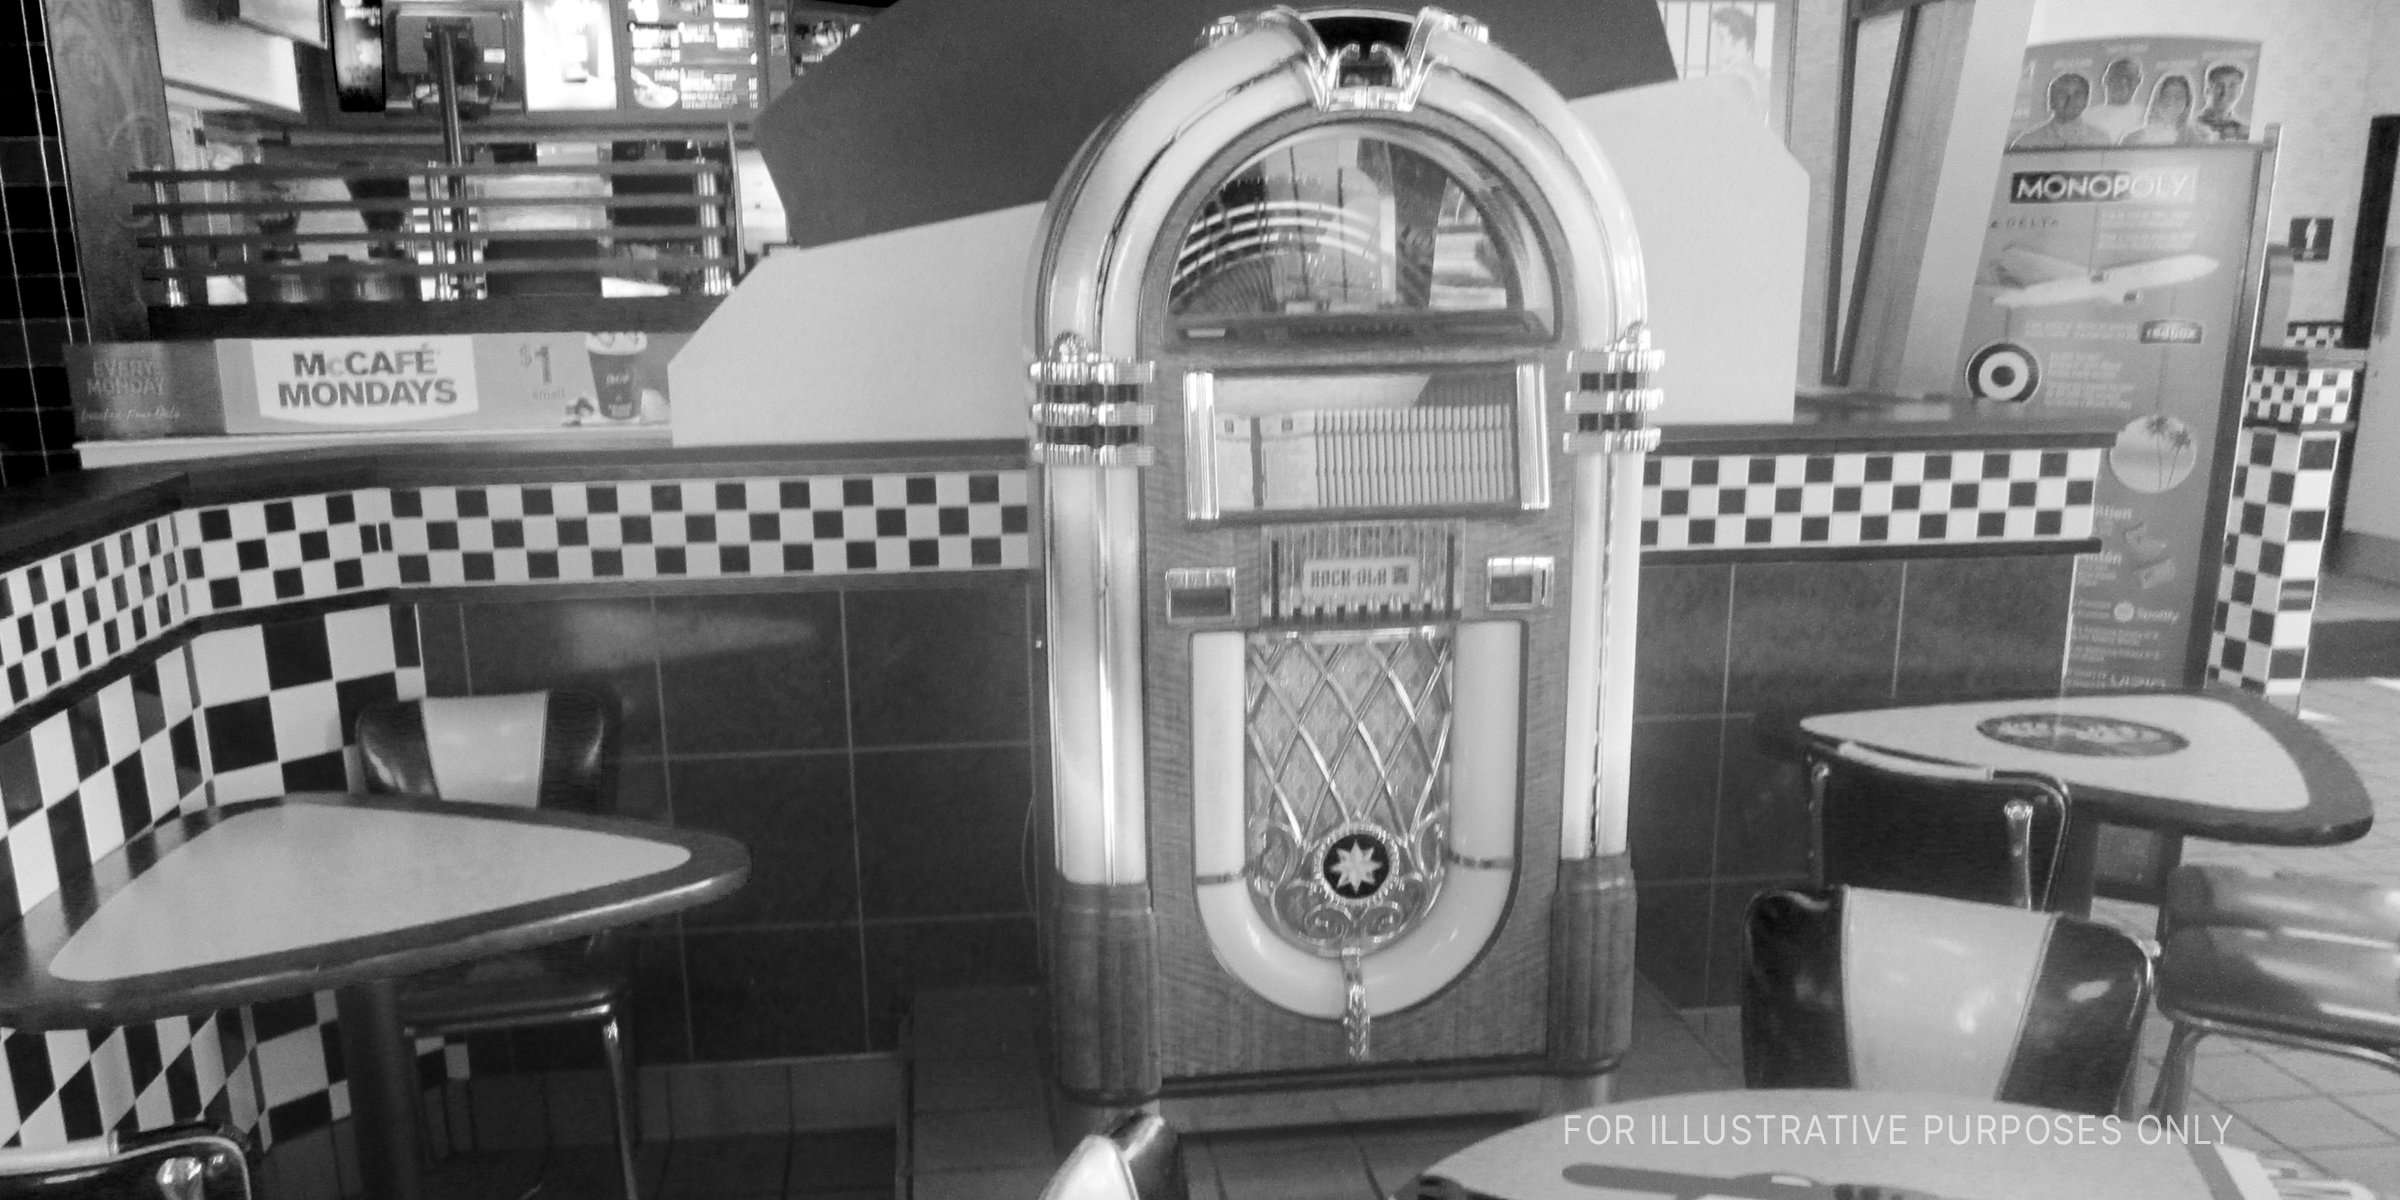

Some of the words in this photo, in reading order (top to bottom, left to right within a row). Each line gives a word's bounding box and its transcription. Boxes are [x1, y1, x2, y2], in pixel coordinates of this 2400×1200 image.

[2015, 173, 2190, 200] MONOPOLY
[86, 378, 165, 396] MONDAY
[277, 377, 457, 408] MONDAYS
